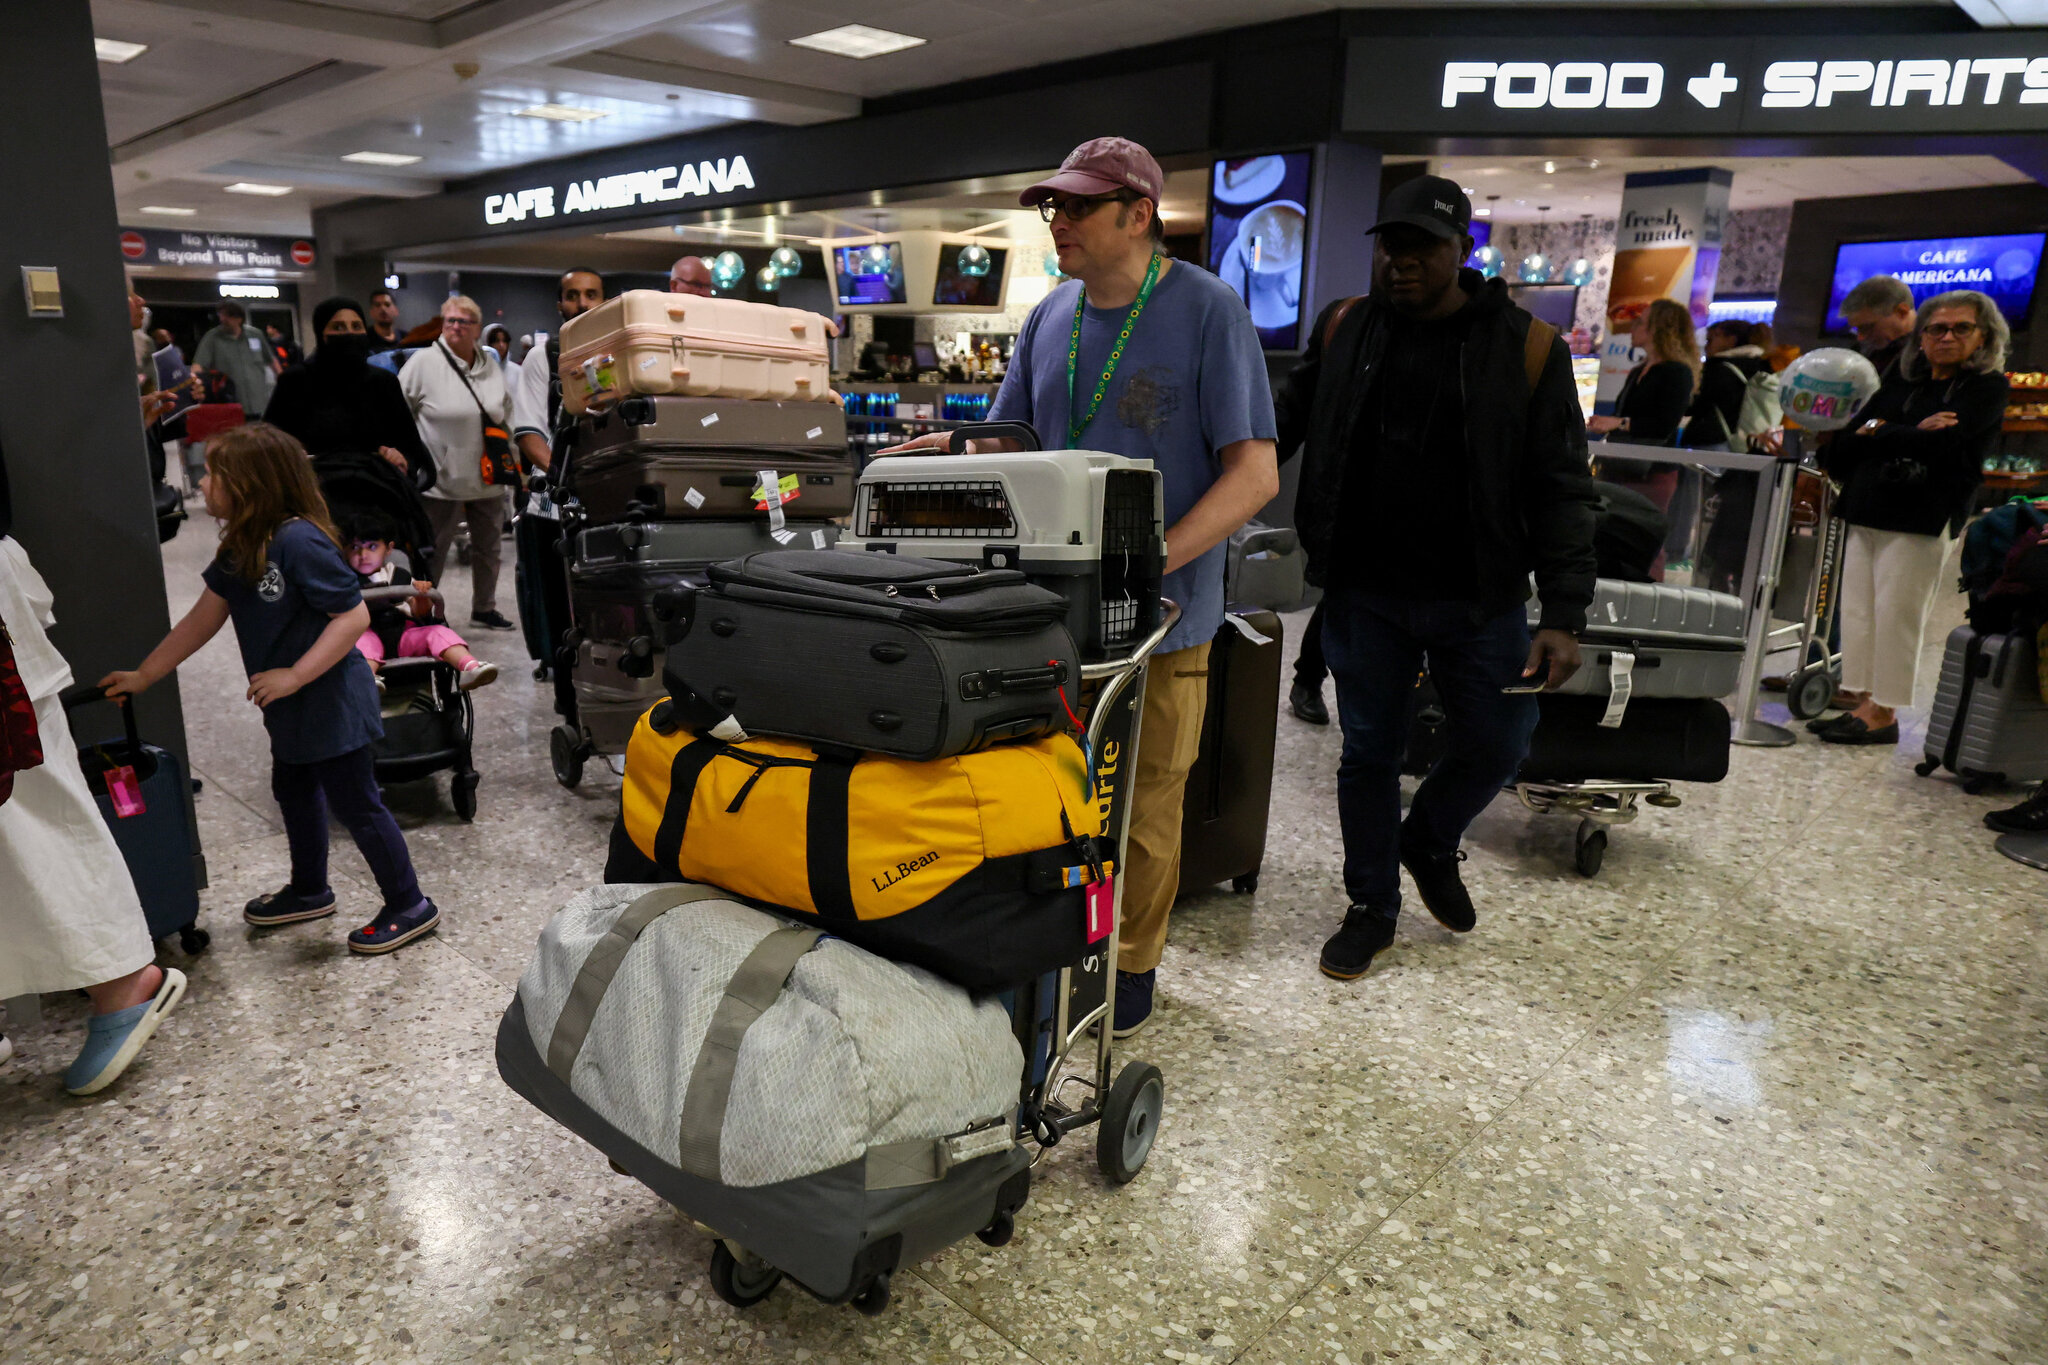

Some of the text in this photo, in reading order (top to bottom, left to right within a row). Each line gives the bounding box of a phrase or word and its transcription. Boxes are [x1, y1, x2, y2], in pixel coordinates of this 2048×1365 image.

[1441, 61, 1664, 108] FOOD
[484, 155, 756, 225] CAFE AMERICANA
[1624, 207, 1679, 229] fresh
[181, 233, 259, 250] No Visitors
[1633, 222, 1693, 243] made
[158, 248, 282, 267] Beyond This Point
[1918, 249, 1968, 265] CAFE
[871, 850, 941, 893] L.L.Bean
